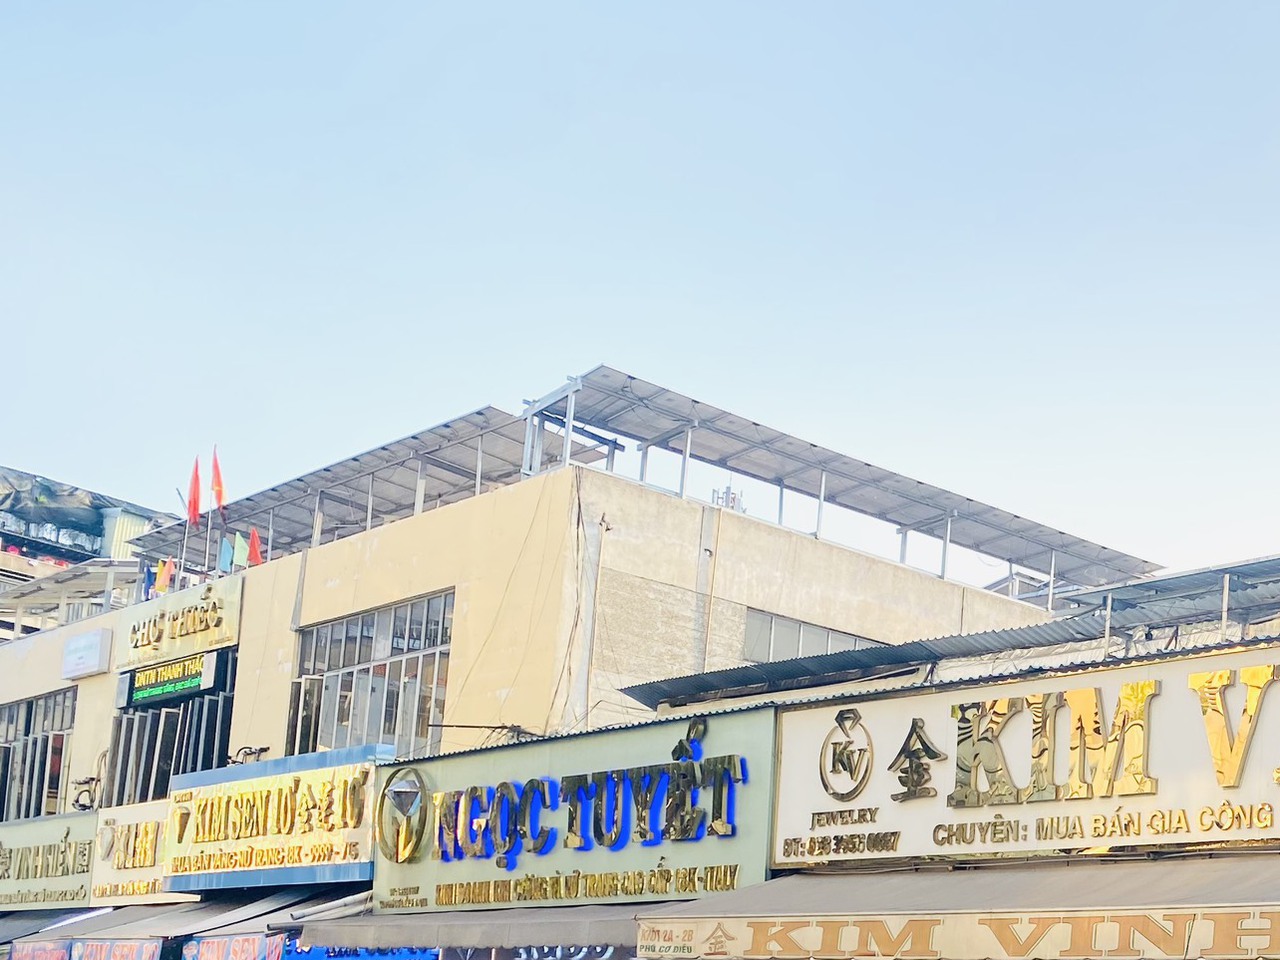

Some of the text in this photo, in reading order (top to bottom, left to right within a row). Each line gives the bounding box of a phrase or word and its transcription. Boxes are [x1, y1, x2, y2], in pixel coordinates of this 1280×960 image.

[129, 610, 166, 651] CHỢ
[157, 661, 184, 682] THANH
[887, 717, 949, 802] 金
[946, 679, 1160, 809] KIM
[432, 717, 745, 869] NGỌC TUYẾT
[810, 807, 880, 830] JEWELRY
[1035, 815, 1085, 841] MUA
[1090, 805, 1141, 839] BÁN
[1146, 808, 1190, 835] GIA
[1199, 799, 1274, 831] CÔNG
[701, 922, 737, 957] 金
[743, 918, 943, 957] KIM
